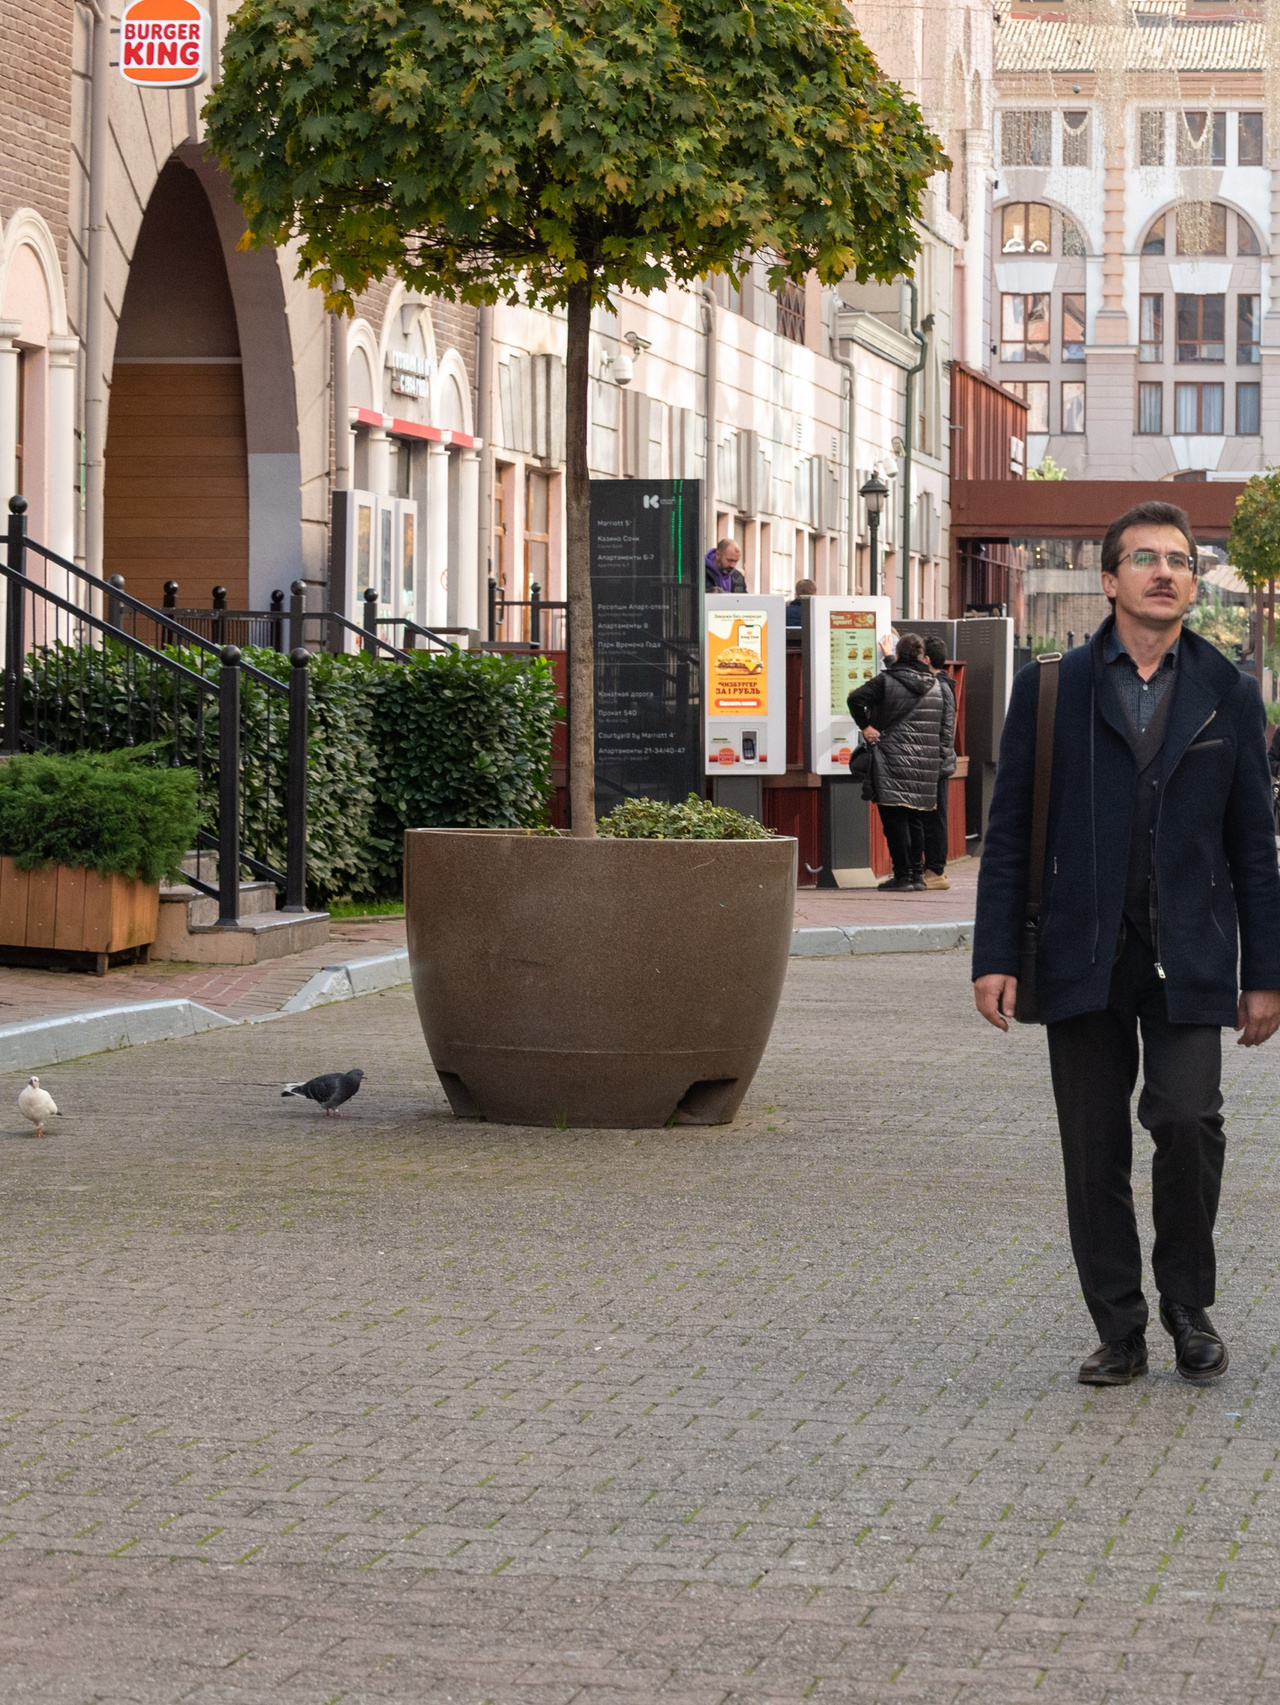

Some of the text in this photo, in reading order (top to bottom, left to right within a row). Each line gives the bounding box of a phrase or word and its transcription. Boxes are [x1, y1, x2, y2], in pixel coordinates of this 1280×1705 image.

[125, 23, 200, 40] BURGER
[124, 41, 200, 66] KING
[597, 554, 642, 562] Апартаменты
[597, 622, 642, 630] Апартаменты
[615, 641, 645, 649] Времена
[645, 641, 661, 649] Года
[597, 732, 631, 740] Courtyard
[632, 732, 640, 740] by
[598, 747, 643, 755] Апартаменты
